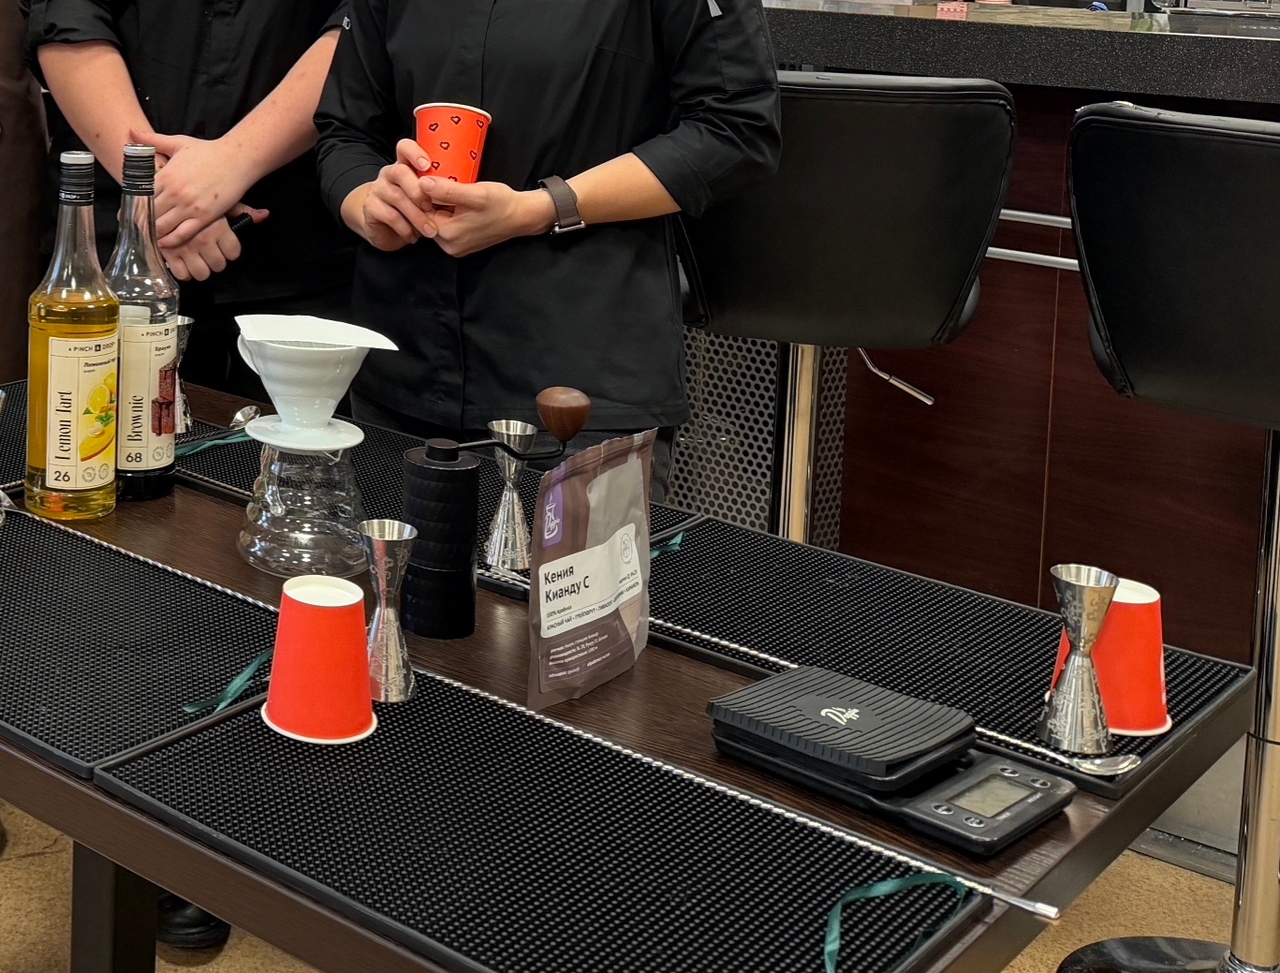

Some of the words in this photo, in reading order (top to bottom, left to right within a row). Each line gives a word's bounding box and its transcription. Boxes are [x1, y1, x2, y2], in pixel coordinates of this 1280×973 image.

[145, 329, 163, 337] PINCH
[55, 390, 72, 415] Tart
[126, 395, 144, 442] Brownie
[54, 419, 72, 460] Lemon
[125, 452, 143, 463] 68
[53, 470, 71, 482] 26
[543, 566, 574, 586] Кения
[545, 580, 582, 604] Кианду
